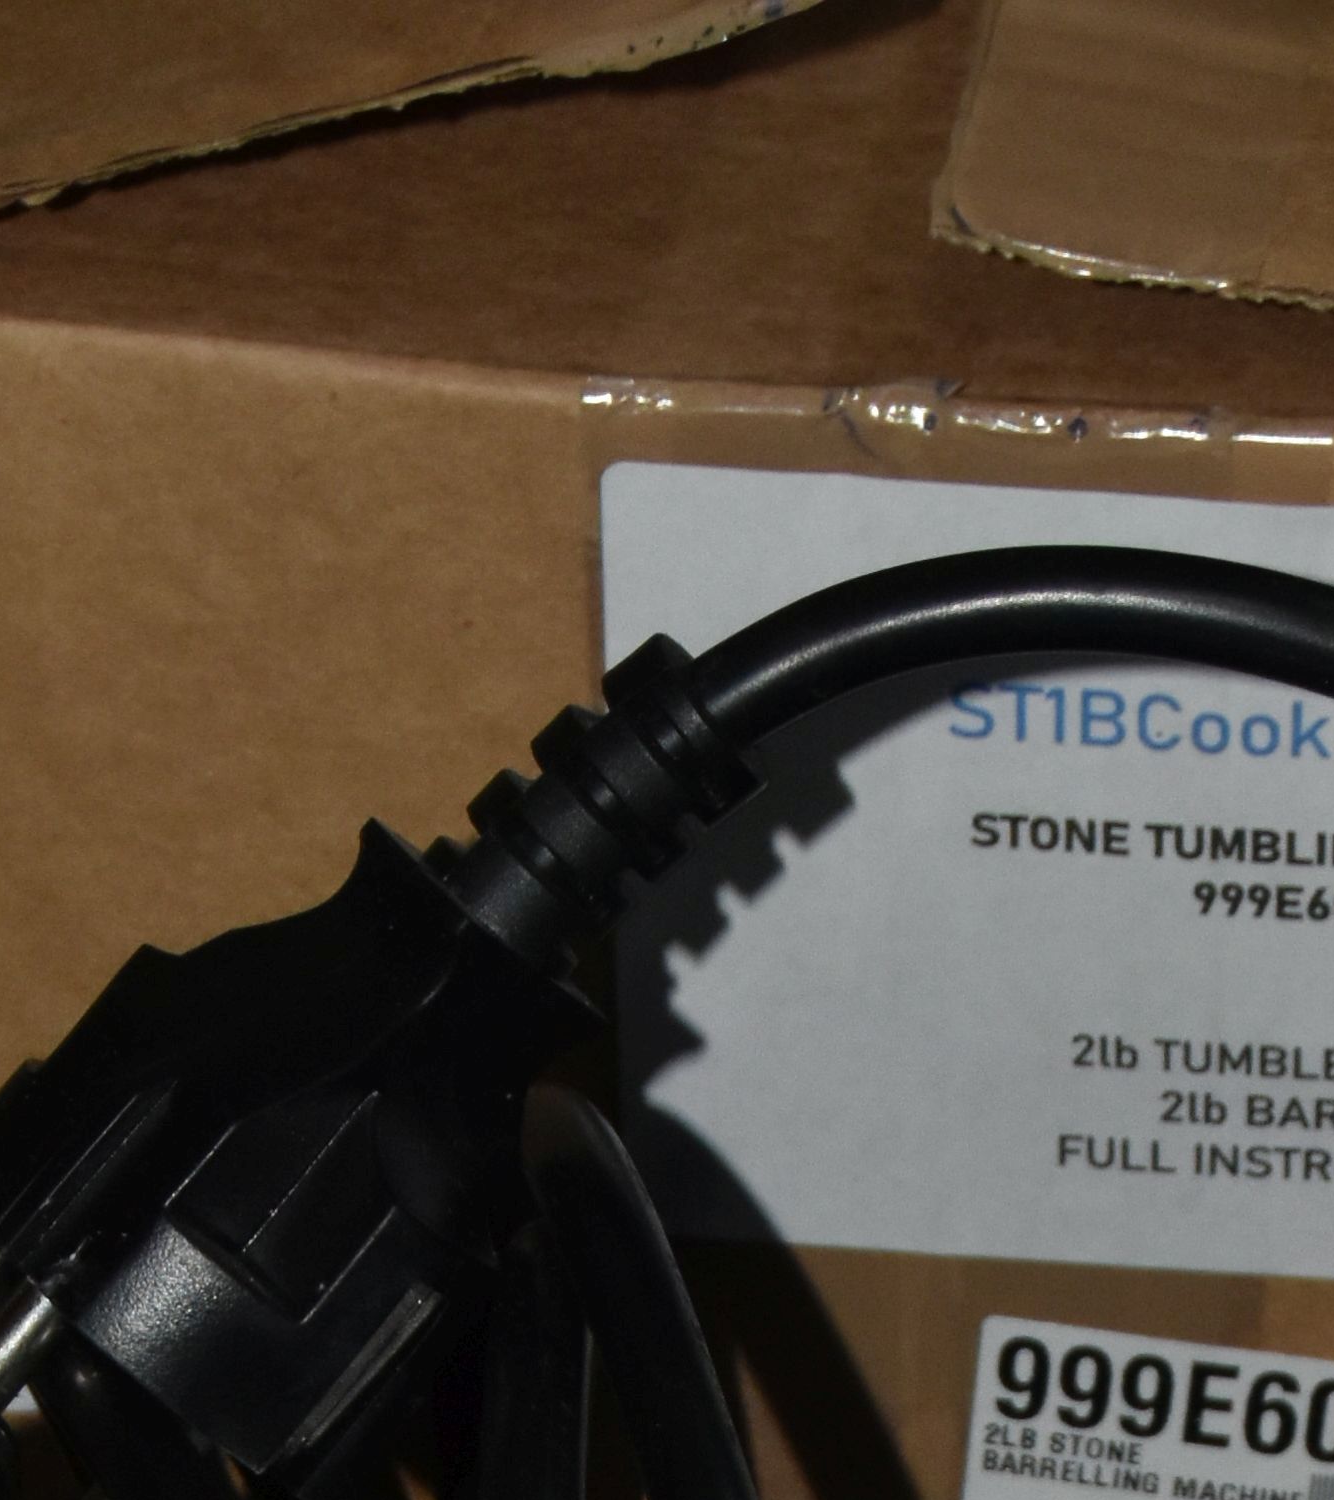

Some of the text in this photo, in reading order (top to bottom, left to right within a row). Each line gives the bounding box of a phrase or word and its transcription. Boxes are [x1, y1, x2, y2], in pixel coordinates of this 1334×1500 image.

[948, 686, 1331, 760] ST1BCook
[970, 811, 1131, 858] STONE
[1071, 1032, 1140, 1071] 2lb
[1159, 1088, 1229, 1127] 2lb
[1056, 1132, 1177, 1175] FULL
[984, 1423, 1139, 1466] 2LB STONE
[981, 1447, 1160, 1496] BARRELLING
